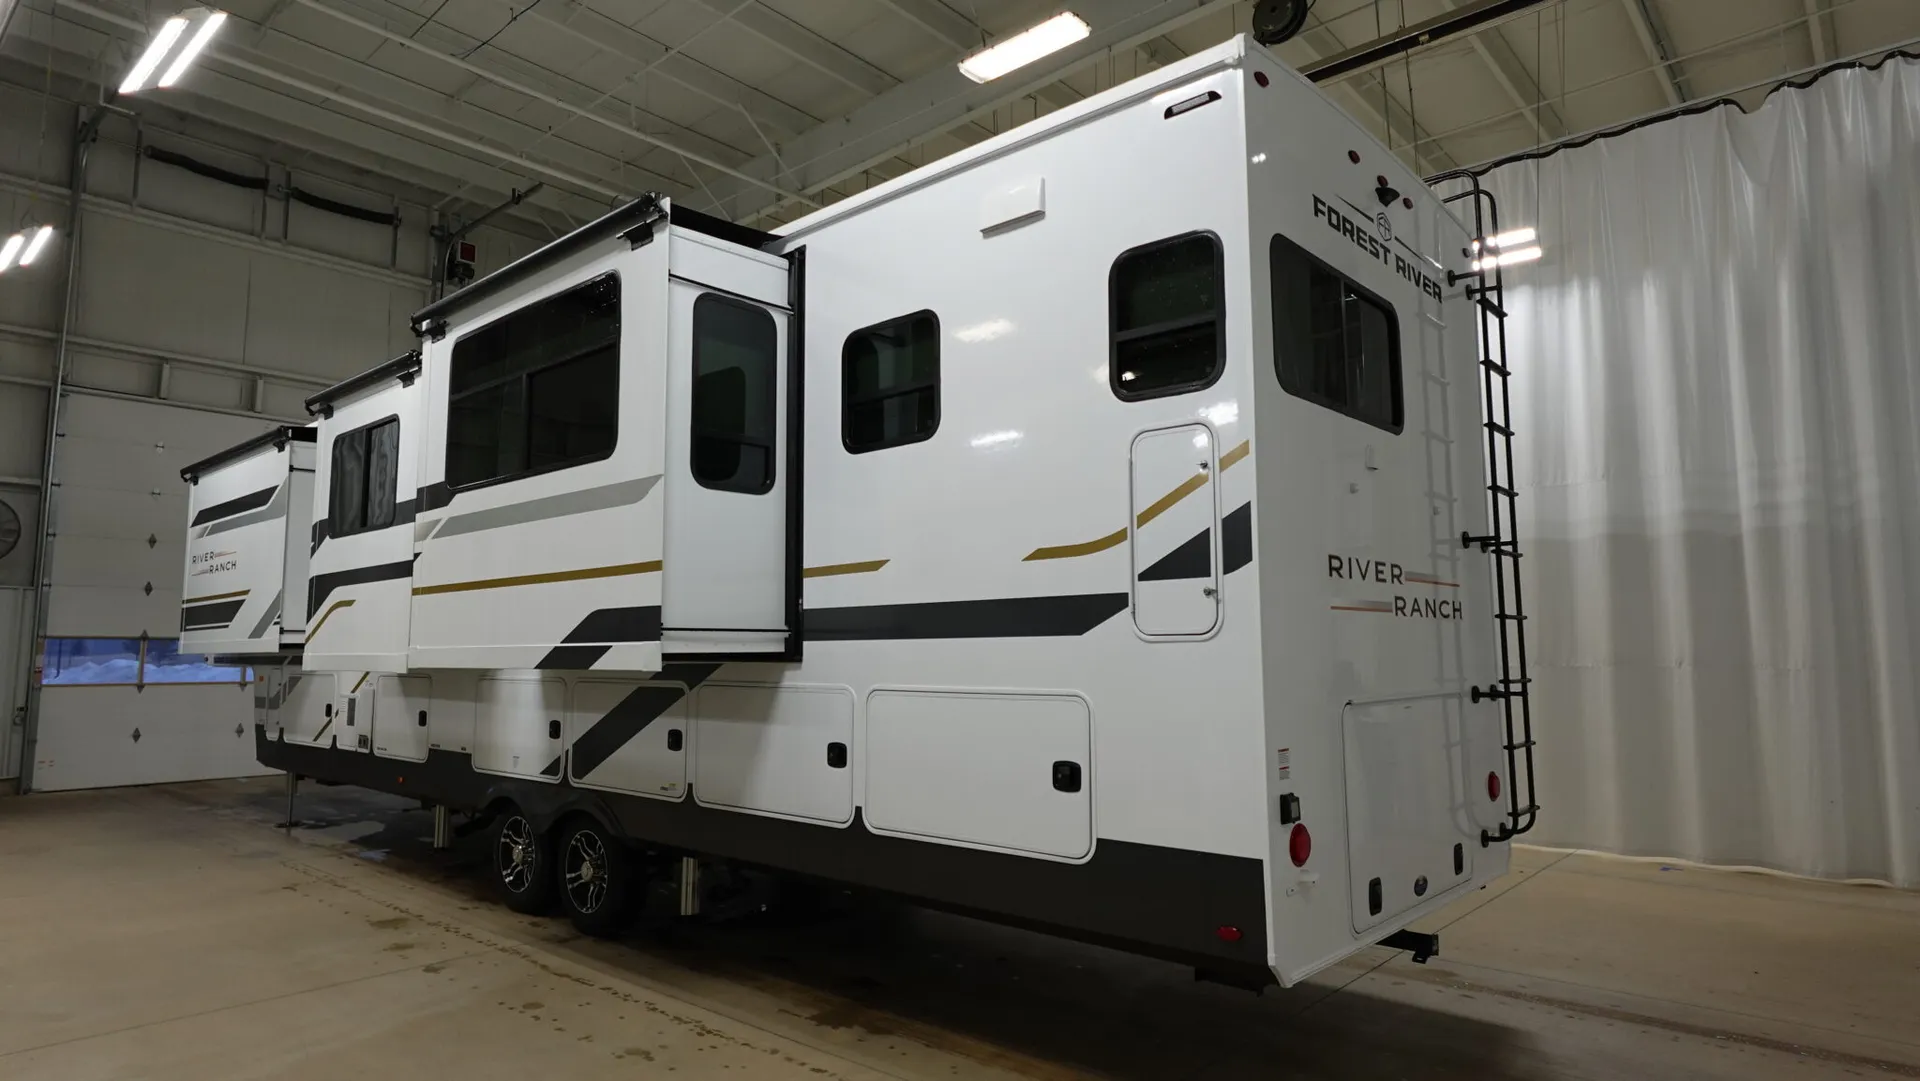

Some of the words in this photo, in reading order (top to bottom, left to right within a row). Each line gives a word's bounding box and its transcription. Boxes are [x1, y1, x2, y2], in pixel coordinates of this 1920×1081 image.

[1313, 194, 1391, 265] FOREST
[1394, 253, 1443, 303] RIVER
[192, 551, 215, 564] RIVER
[209, 560, 237, 575] RANCH
[1328, 554, 1404, 585] RIVER
[1394, 595, 1463, 620] RANCH
